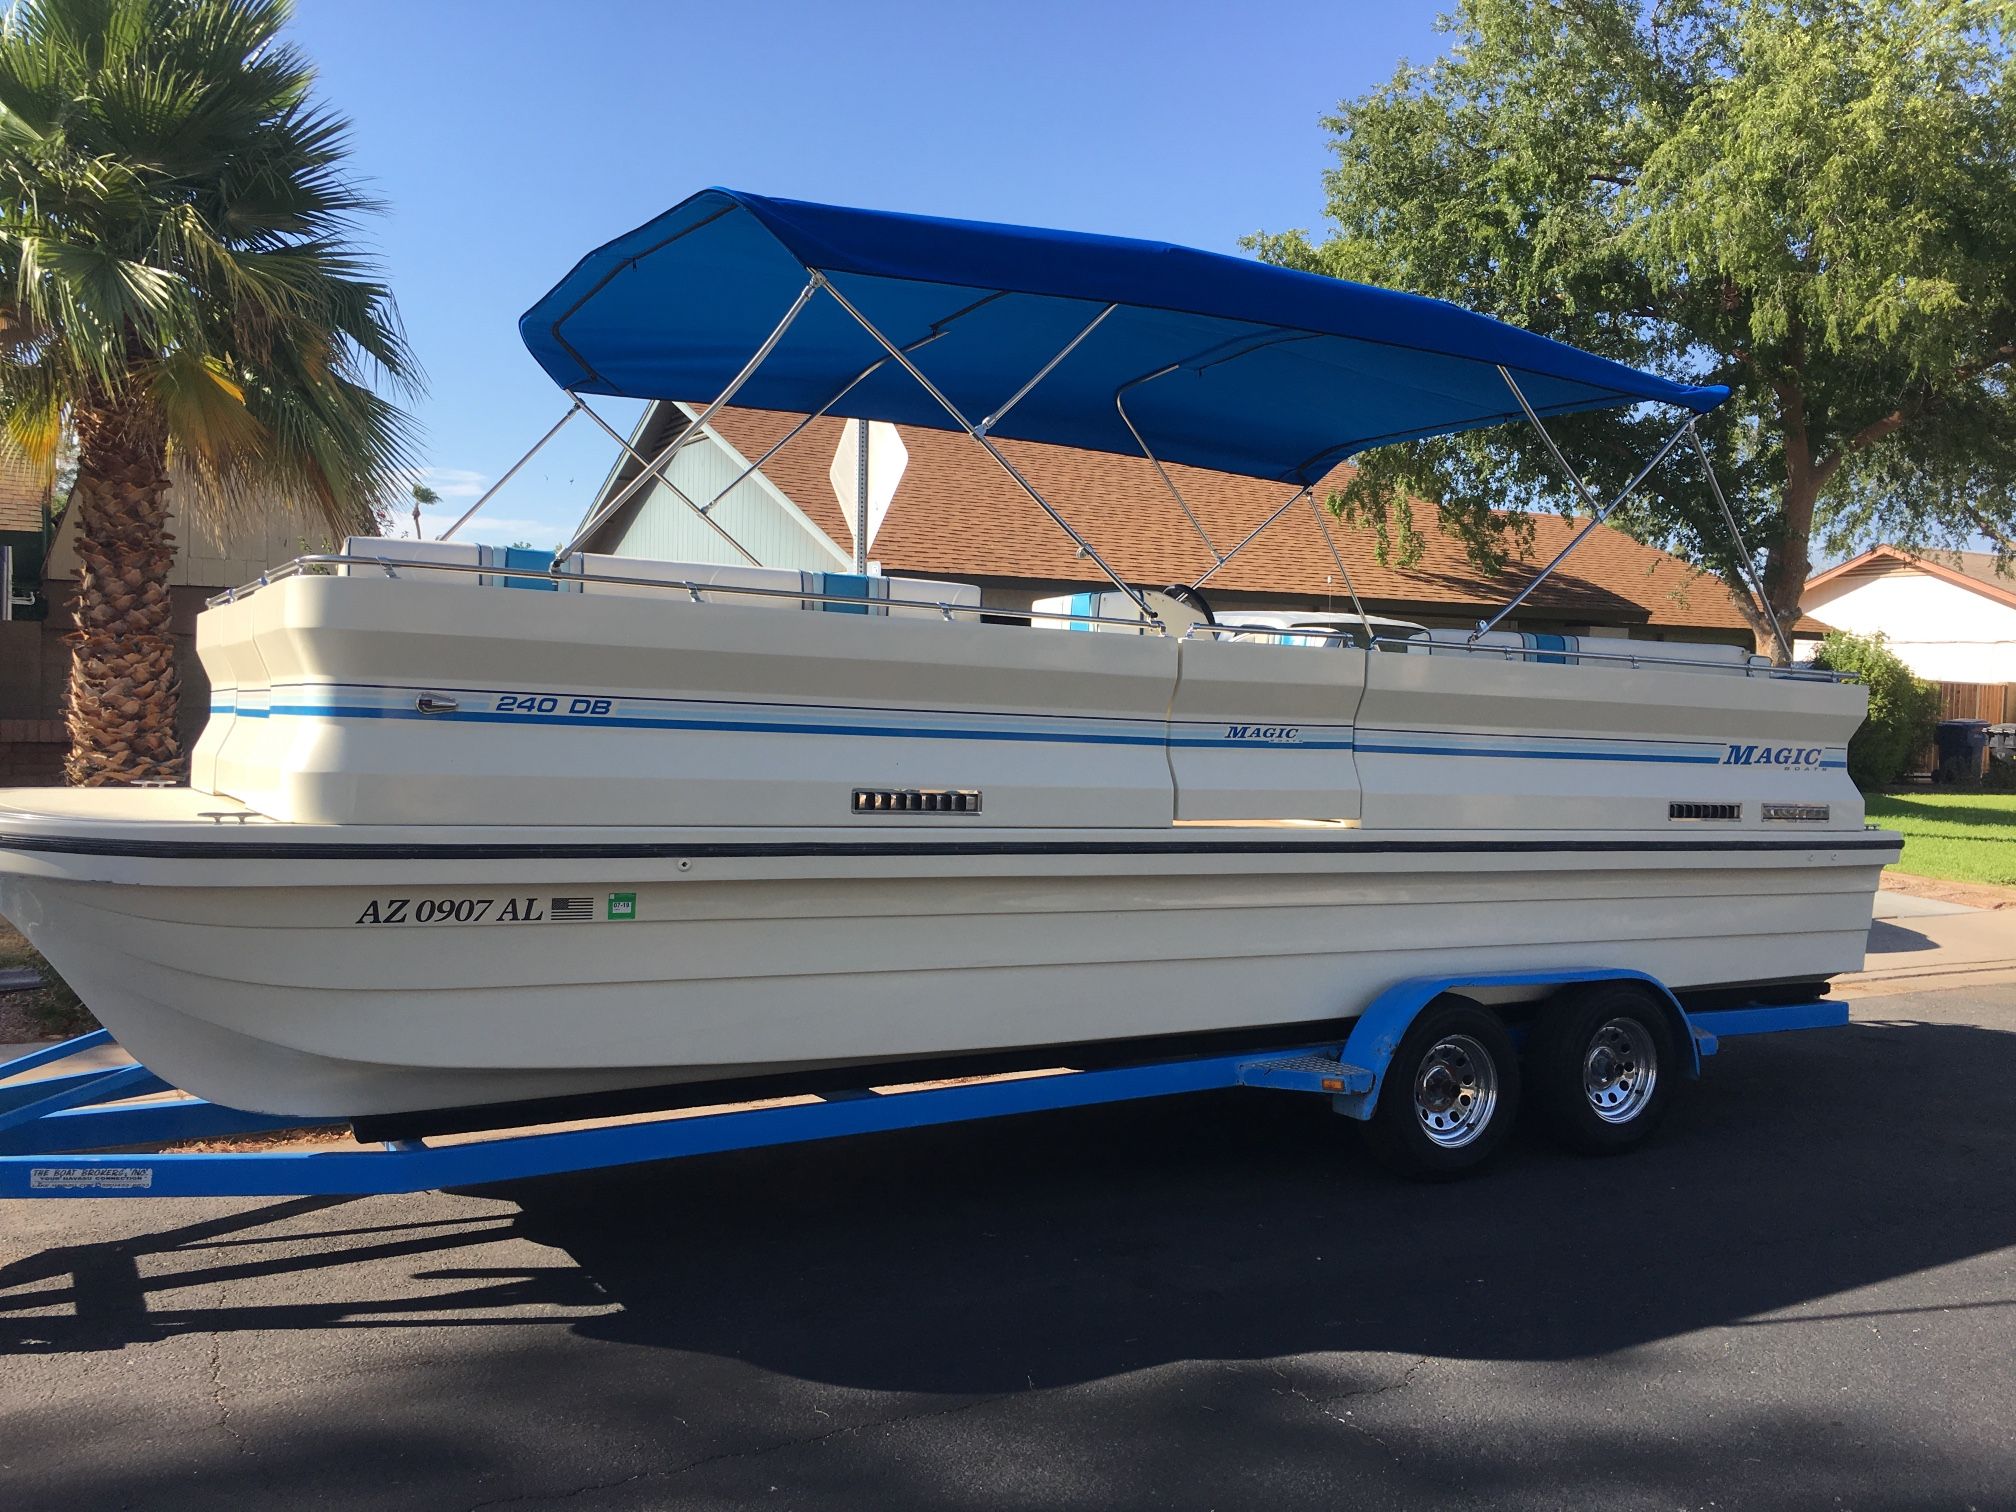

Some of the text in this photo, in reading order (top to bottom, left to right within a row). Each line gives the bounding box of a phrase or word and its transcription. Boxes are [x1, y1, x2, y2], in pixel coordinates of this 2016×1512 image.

[496, 696, 612, 715] 240 DB
[1224, 725, 1299, 739] MAGIC
[1722, 744, 1822, 766] MAGIC
[355, 898, 544, 924] AZ 0907 AL
[33, 1169, 50, 1177] THE
[53, 1169, 78, 1177] BOAT
